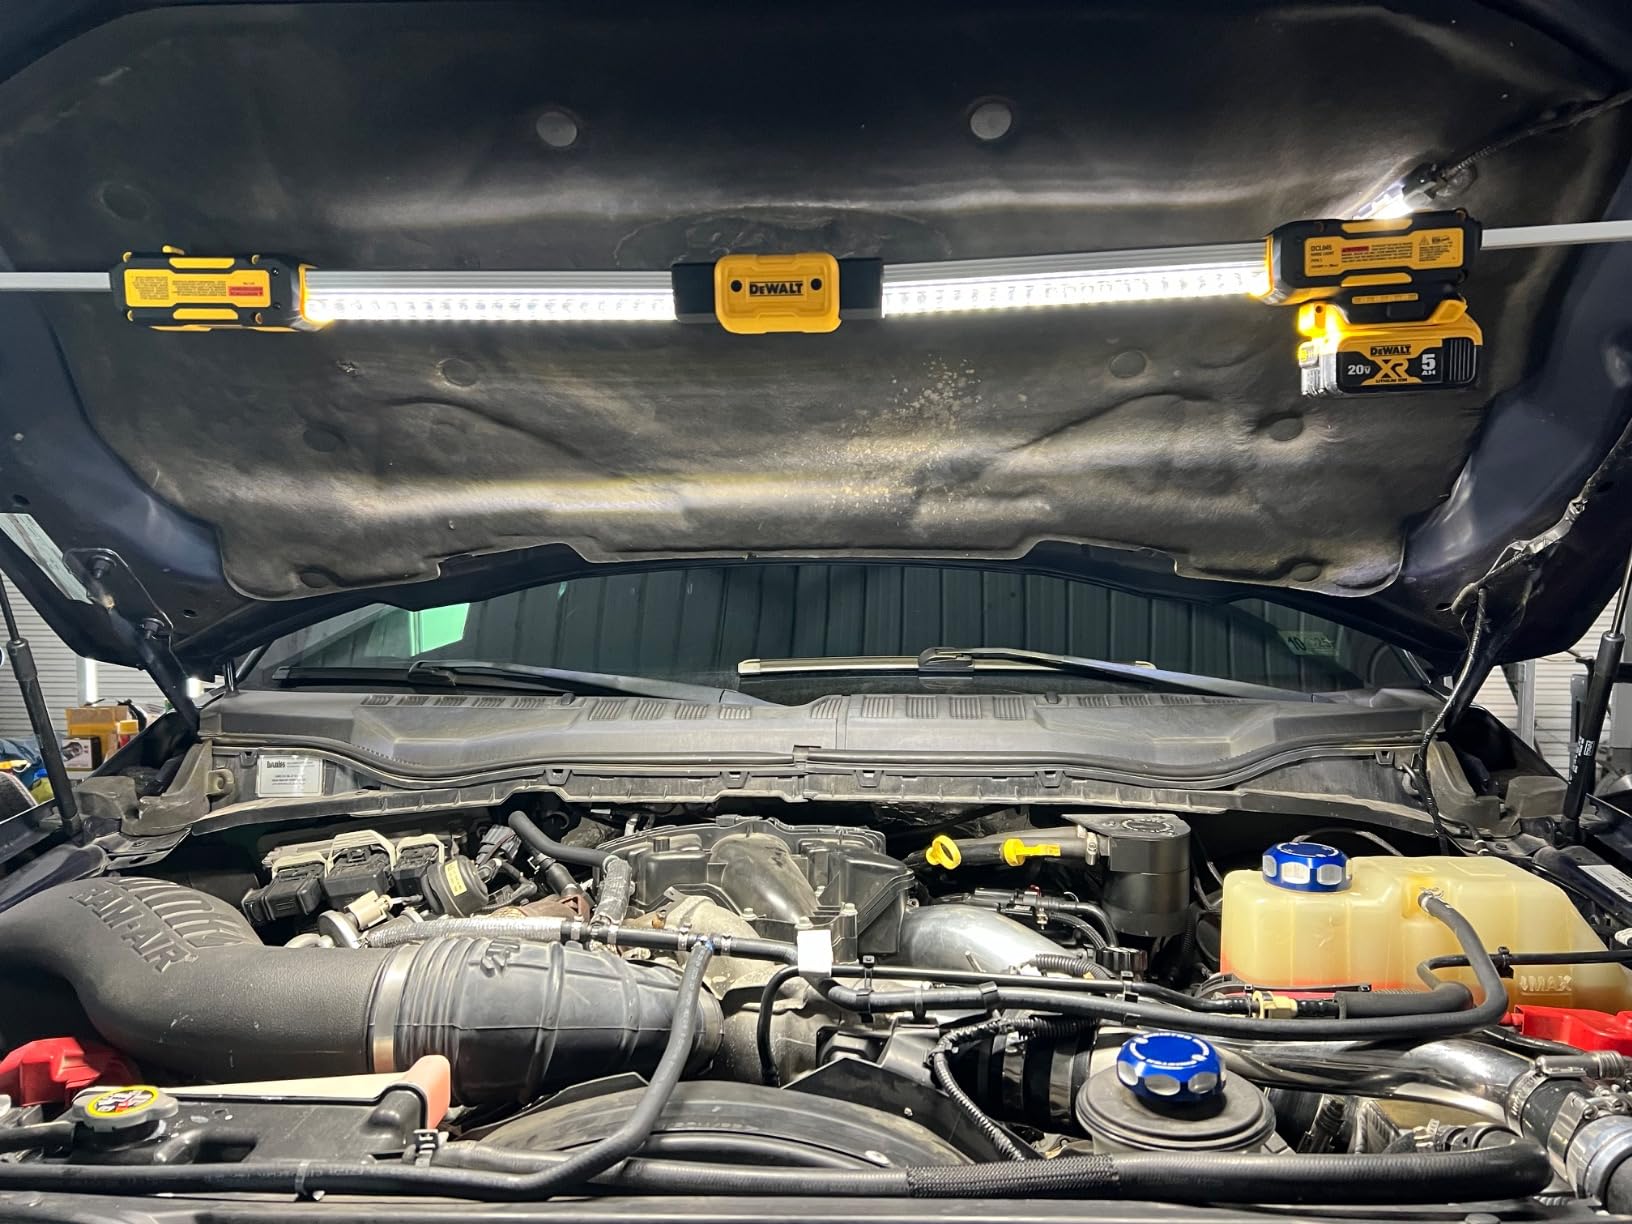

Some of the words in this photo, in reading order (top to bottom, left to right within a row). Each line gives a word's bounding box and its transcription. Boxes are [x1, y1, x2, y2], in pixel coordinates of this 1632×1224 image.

[1374, 358, 1410, 379] XR
[1421, 353, 1436, 371] 5
[1287, 636, 1307, 651] 10
